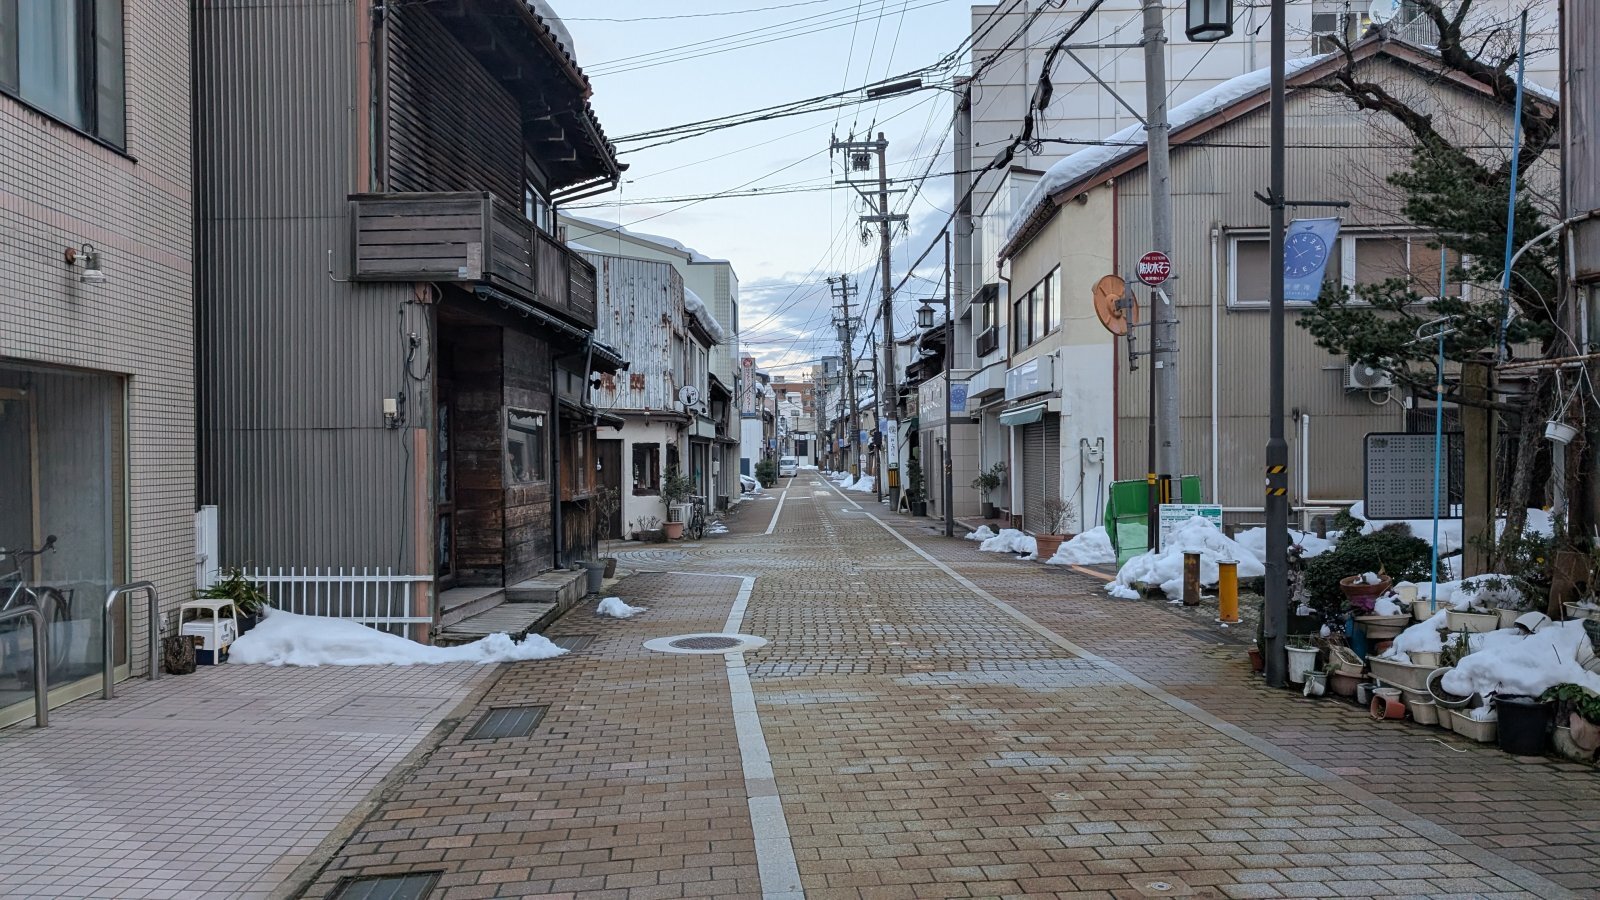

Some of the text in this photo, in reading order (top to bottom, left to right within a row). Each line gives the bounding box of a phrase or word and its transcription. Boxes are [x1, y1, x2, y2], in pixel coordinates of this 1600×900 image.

[1139, 262, 1170, 274] 防火水そう
